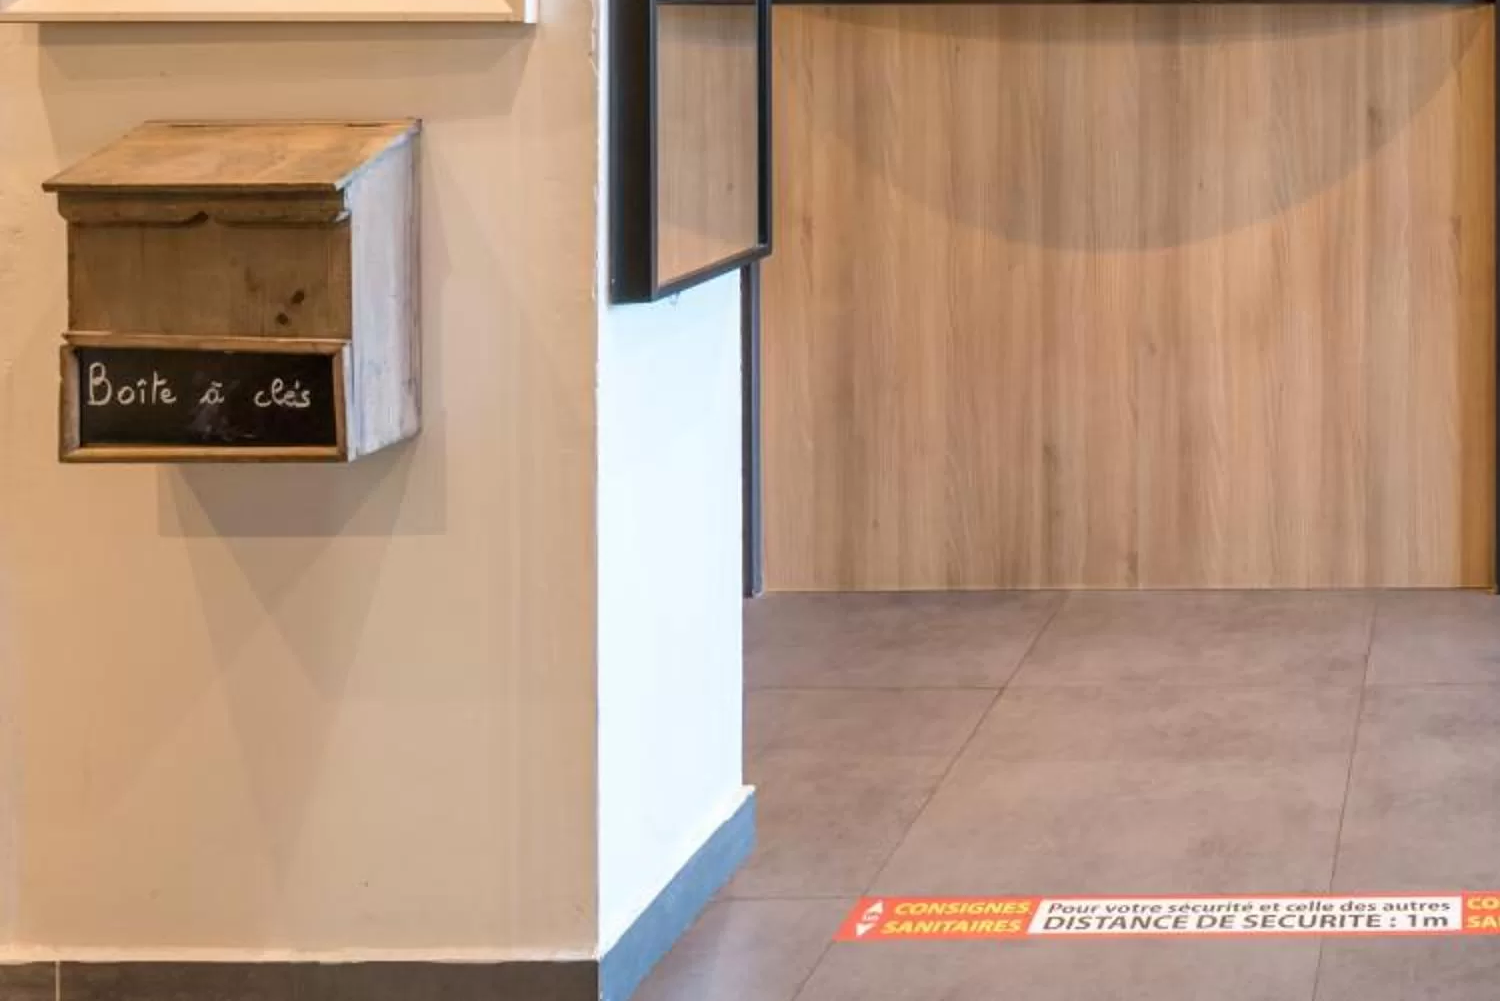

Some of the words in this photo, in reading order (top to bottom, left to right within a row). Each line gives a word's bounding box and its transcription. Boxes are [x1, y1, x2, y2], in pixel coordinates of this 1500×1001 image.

[253, 378, 311, 408] clés
[894, 900, 1031, 916] CONSIGNES
[1049, 902, 1099, 914] Pour
[1105, 902, 1161, 914] votre
[1260, 902, 1280, 912] et
[1286, 900, 1334, 912] celle
[1340, 900, 1377, 912] des
[1382, 900, 1451, 912] autres
[880, 918, 1022, 935] SANITAIRES
[1043, 915, 1189, 930] DISTANCE
[1195, 914, 1237, 929] DE
[1407, 913, 1449, 928] 1m
